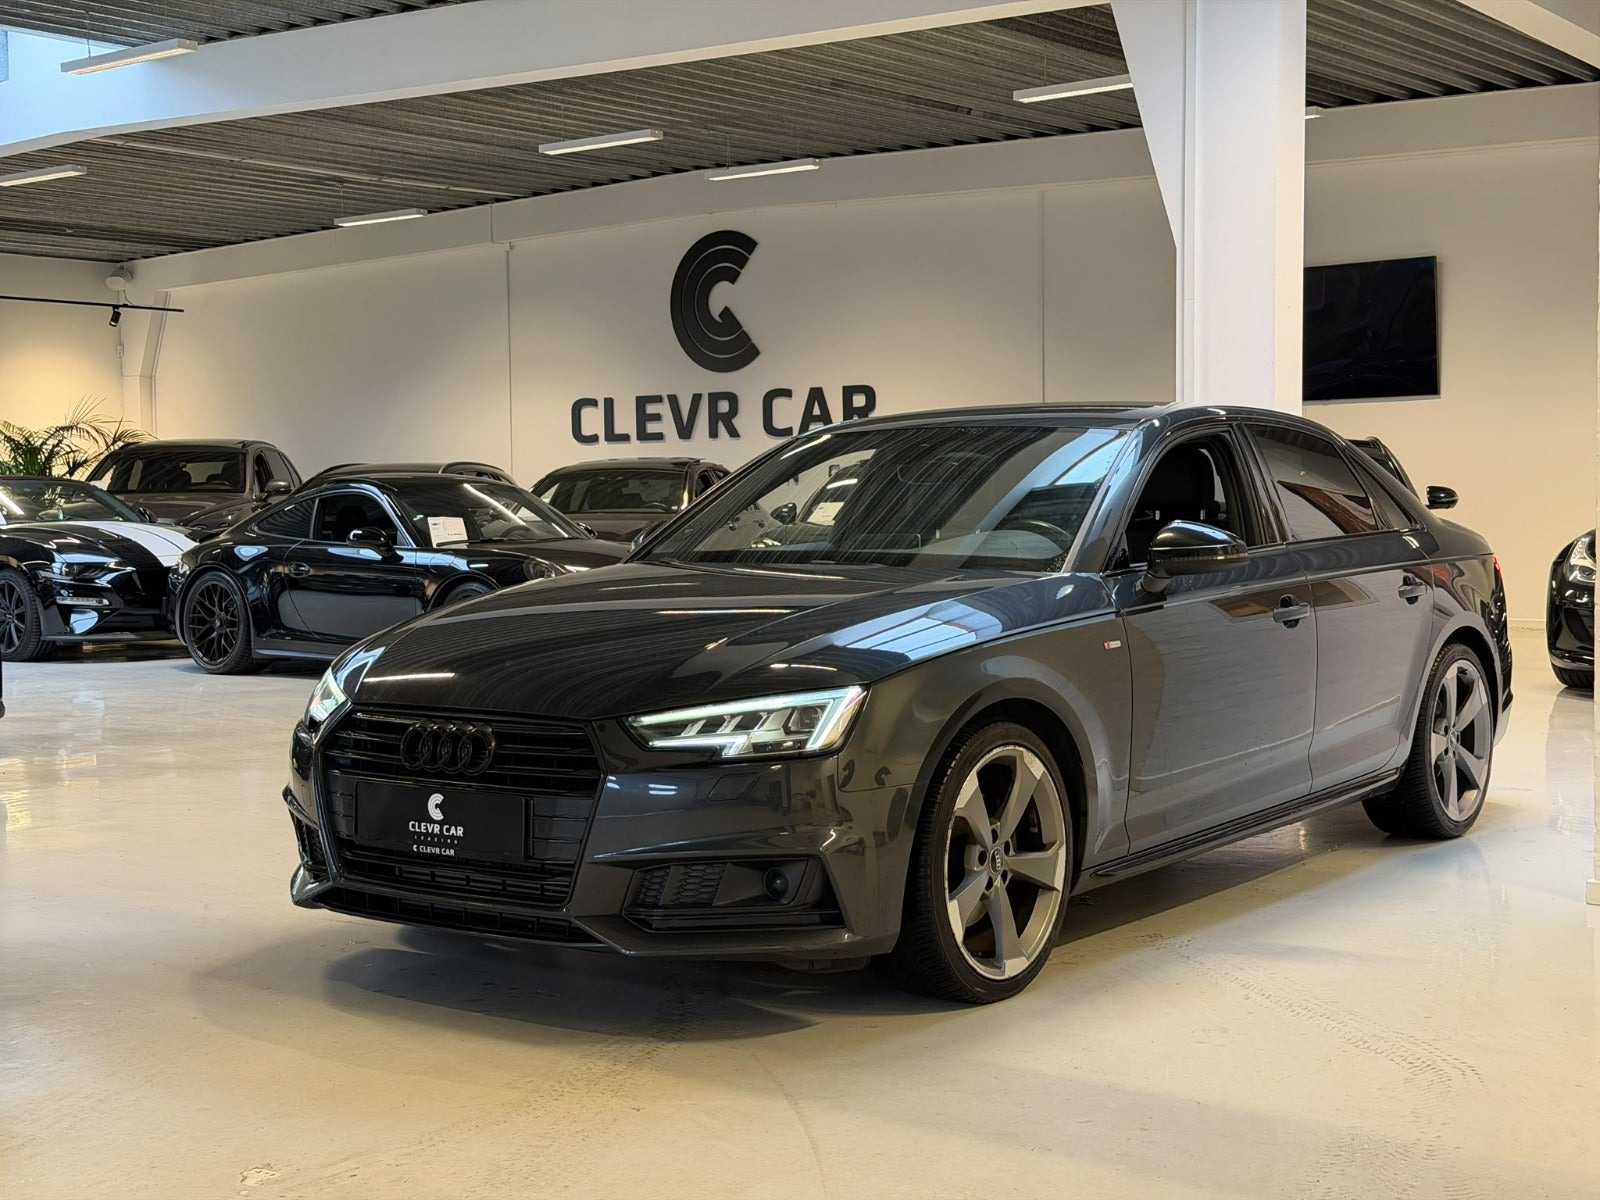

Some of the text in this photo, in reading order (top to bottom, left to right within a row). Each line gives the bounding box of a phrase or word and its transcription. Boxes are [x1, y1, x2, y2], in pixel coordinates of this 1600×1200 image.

[570, 384, 877, 444] CLEVR CAR
[409, 821, 464, 837] CLEVR CAR
[419, 846, 440, 854] CLEVR
[441, 848, 455, 856] CAR
